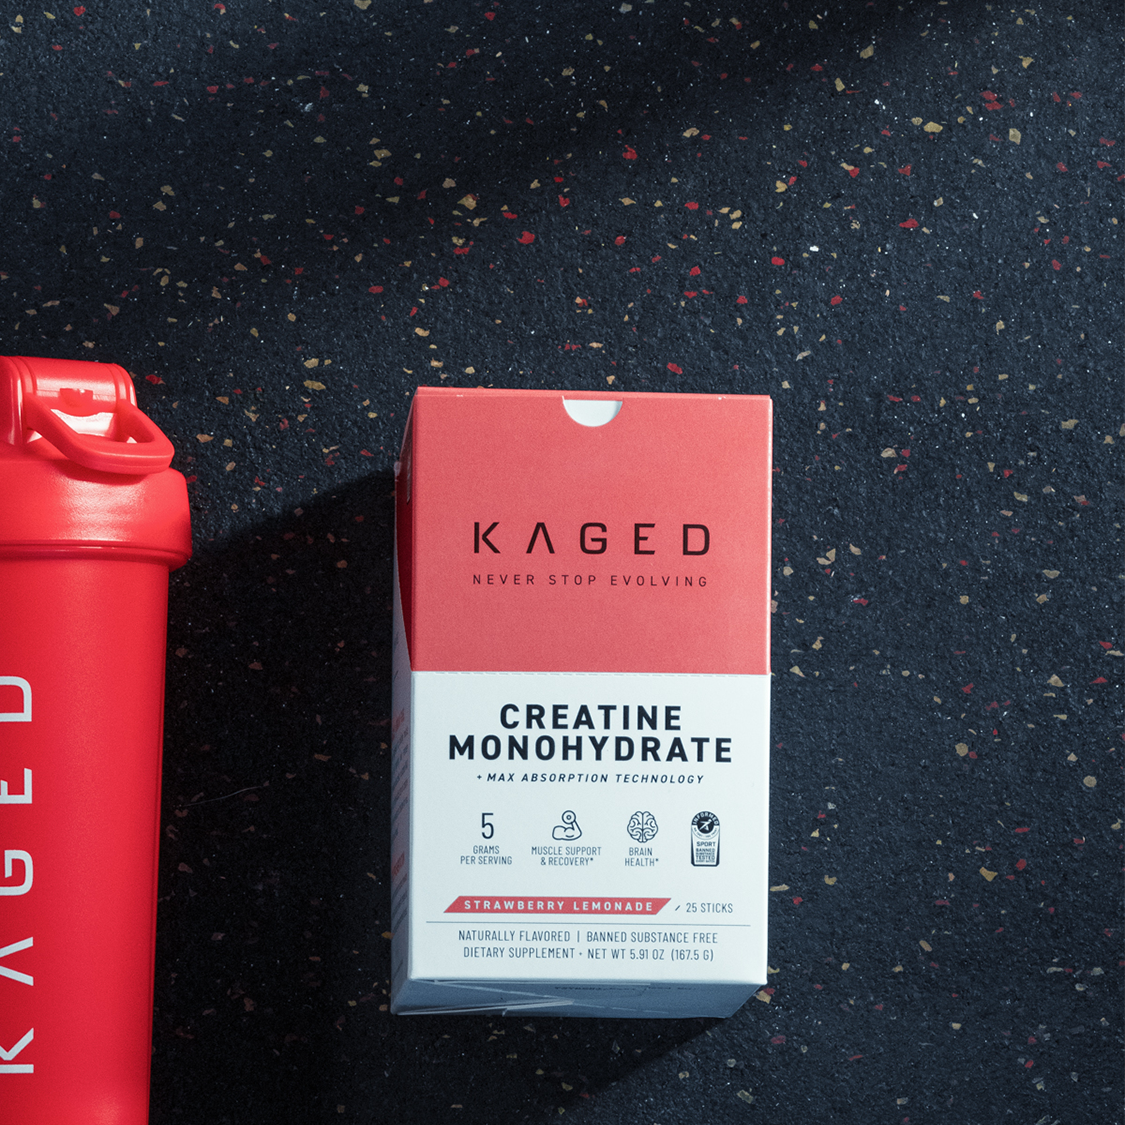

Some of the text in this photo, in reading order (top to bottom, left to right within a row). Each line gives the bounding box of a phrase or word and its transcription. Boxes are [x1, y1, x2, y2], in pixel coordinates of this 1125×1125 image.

[473, 574, 708, 588] NEVER STOP EVOLVING
[500, 703, 682, 731] CREATINE
[449, 735, 732, 763] MONOHYDRATE
[487, 773, 515, 782] MAX
[521, 773, 608, 783] ABSORPTION
[615, 774, 704, 784] TECHNOLOGY
[692, 811, 719, 825] INFORMED
[481, 812, 494, 840] 5
[473, 845, 500, 855] GRAMS
[531, 846, 602, 857] MUSCLE SUPPORT
[629, 847, 653, 857] BRAIN
[460, 856, 512, 865] PER SERVING
[540, 857, 546, 866] &
[464, 900, 653, 912] STRAWBERRY LEMONADE
[686, 902, 733, 914] 25 STICKS
[458, 930, 571, 942] NATURALLY FLAVORED
[586, 931, 718, 944] BANNED SUBSTANCE FREE
[463, 947, 575, 959] DIETARY SUPPLEMENT
[587, 948, 714, 962] NET WT 5.91 OZ (167.5 G)
